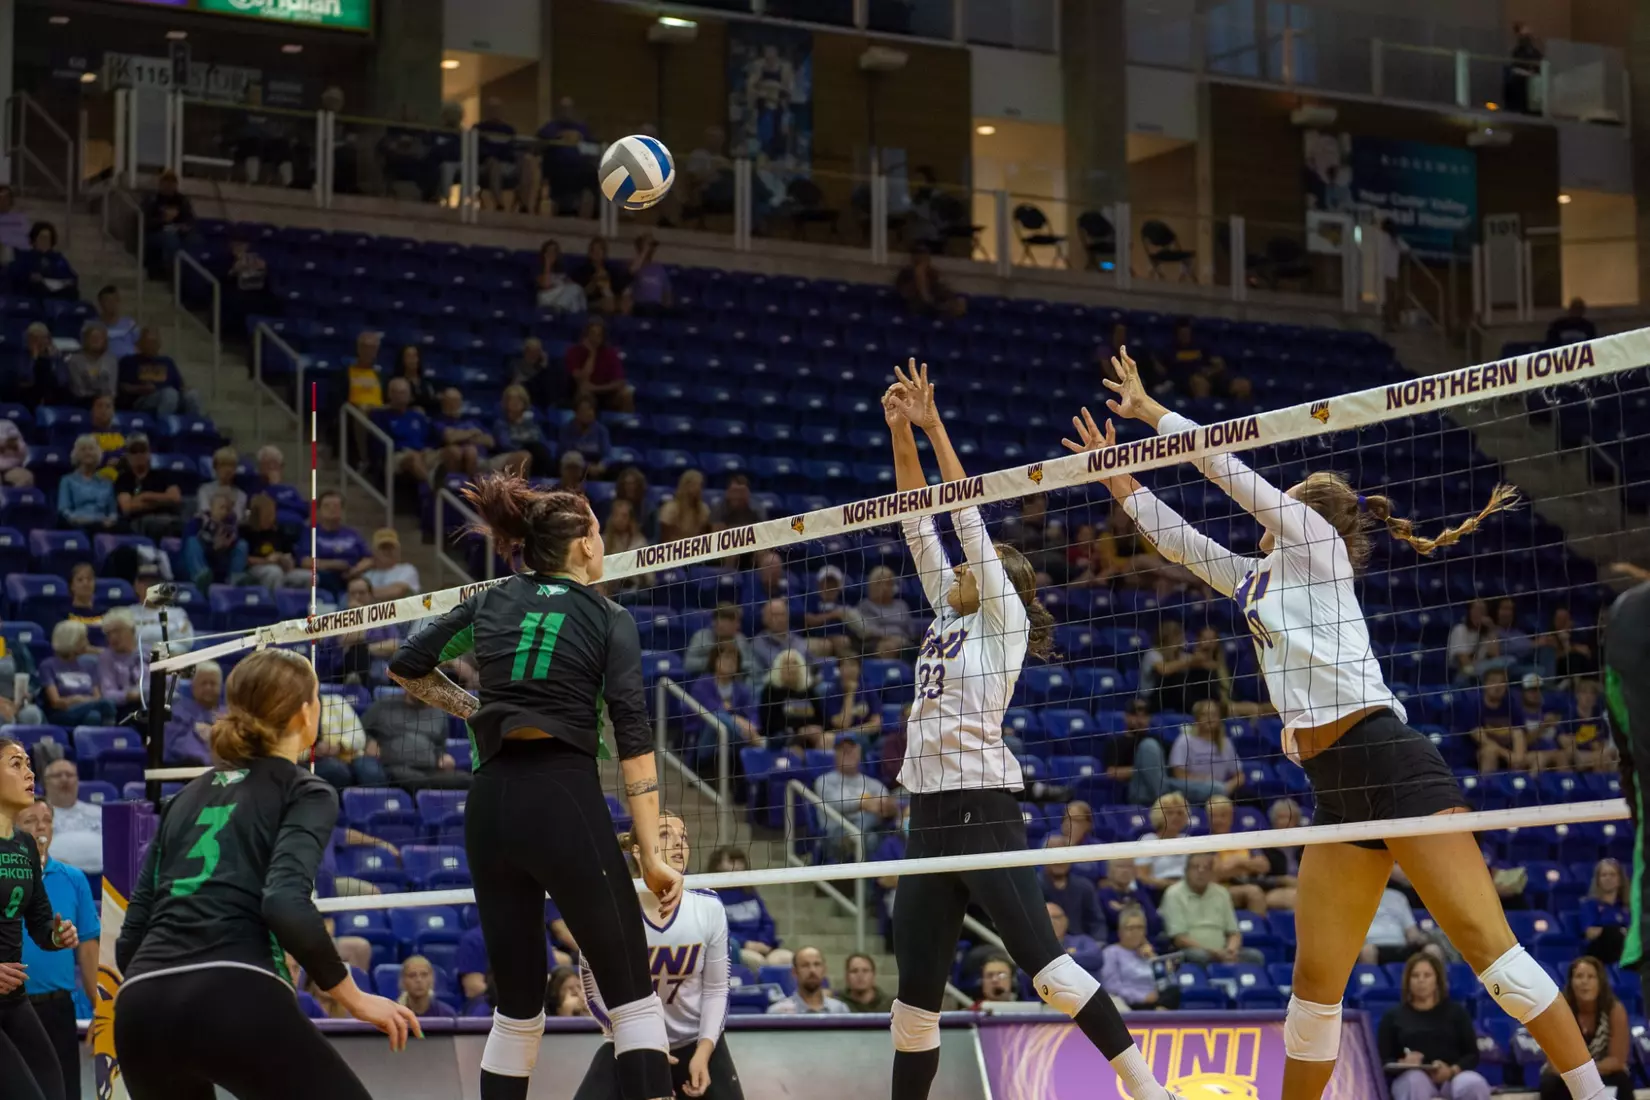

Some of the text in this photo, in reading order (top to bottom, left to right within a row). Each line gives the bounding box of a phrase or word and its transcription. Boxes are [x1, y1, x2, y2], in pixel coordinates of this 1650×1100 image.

[1386, 343, 1596, 410] NORTHERN IOWA
[1087, 416, 1260, 473] NORTHERN IOWA
[843, 476, 985, 525] NORTHERN IOWA
[636, 526, 757, 568] NORTHERN IOWA
[367, 602, 397, 622] IOWA
[511, 612, 566, 681] 11
[170, 803, 238, 896] 3
[648, 943, 703, 976] NI
